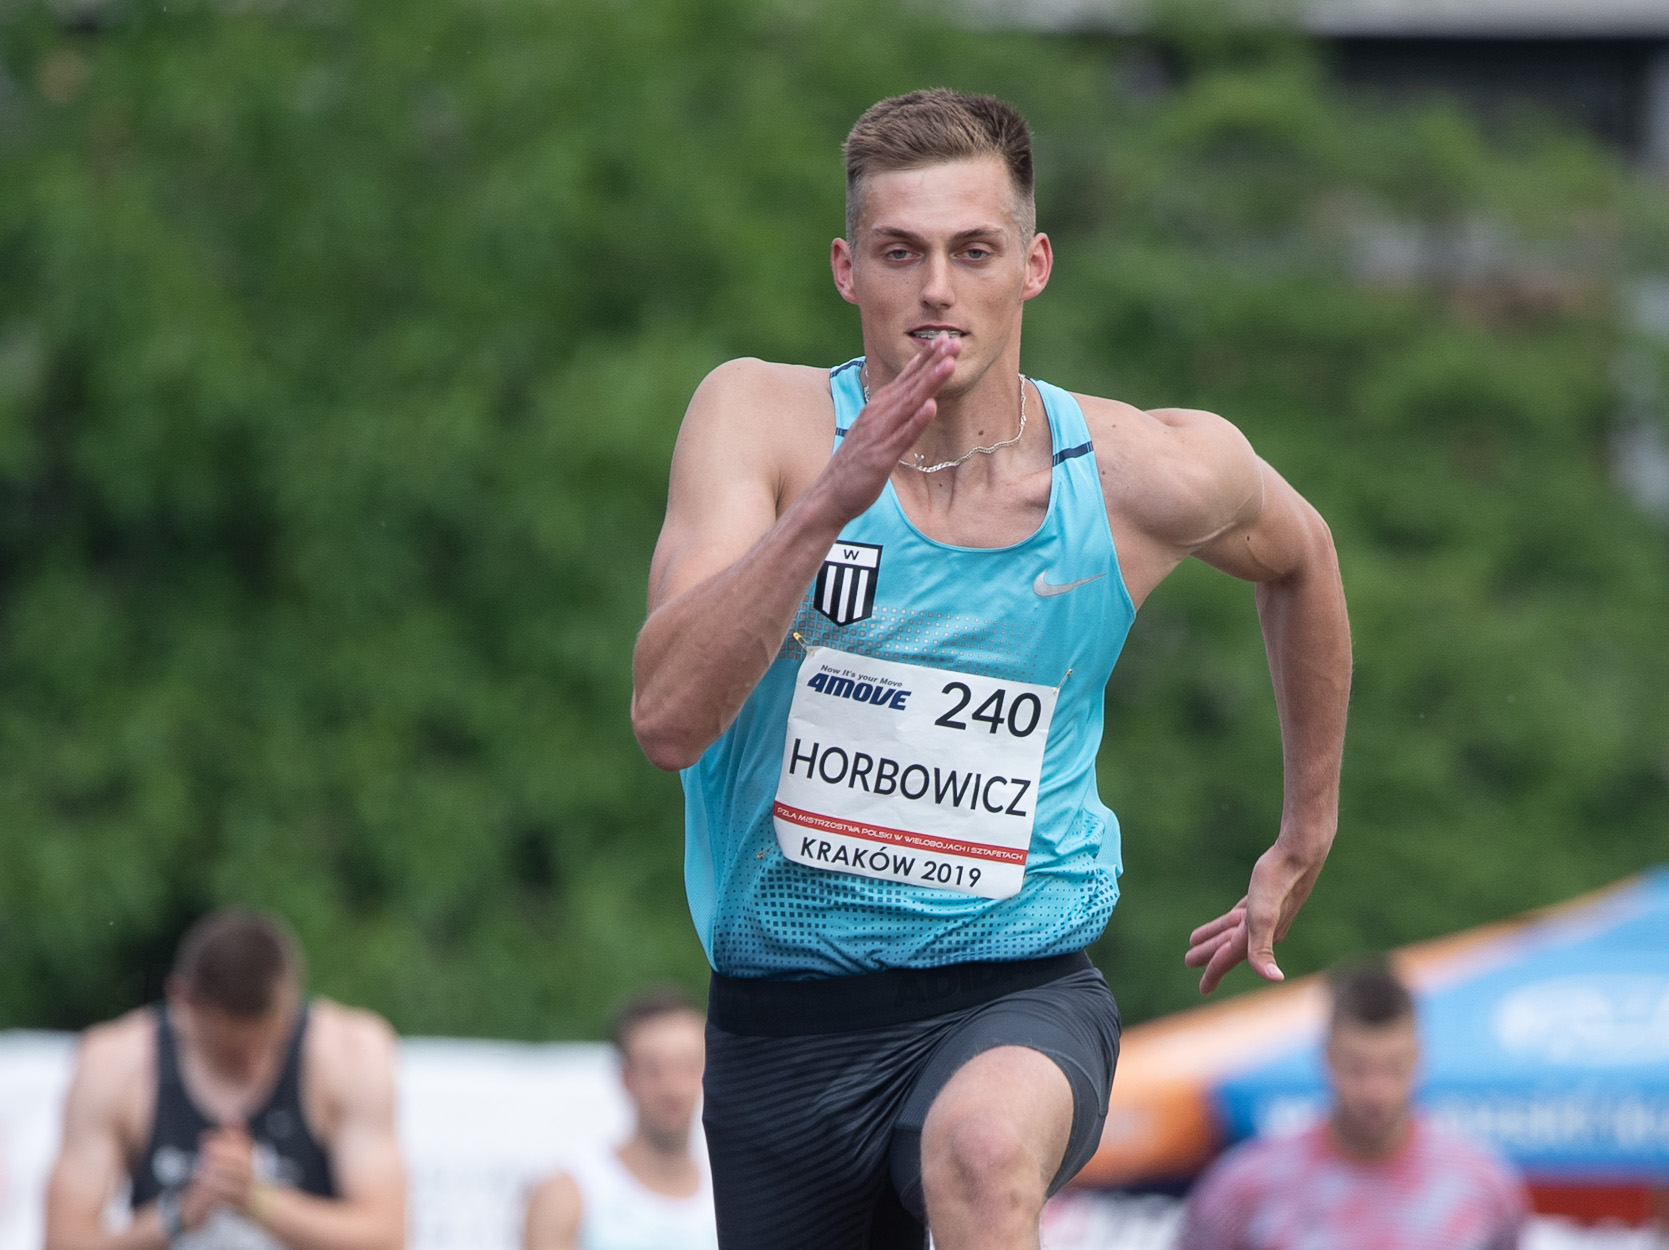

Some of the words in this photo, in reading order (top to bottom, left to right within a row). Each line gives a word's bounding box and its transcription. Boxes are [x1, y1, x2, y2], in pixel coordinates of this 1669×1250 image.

[843, 548, 860, 561] W
[807, 672, 912, 711] 4MOVE
[820, 664, 841, 675] Now
[842, 669, 856, 678] It's
[858, 673, 879, 683] your
[879, 677, 903, 688] Move
[934, 681, 1042, 738] 240
[788, 738, 1031, 817] HORBOWICZ
[777, 807, 798, 820] PZLA
[798, 813, 860, 834] MISTRZOSTWA
[861, 827, 893, 840] POLSKI
[894, 833, 903, 842] W
[904, 835, 966, 852] WIELOBOJACH
[971, 847, 1023, 861] SZTAFETACH
[800, 836, 916, 877] KRAKÓW
[920, 861, 982, 888] 2019
